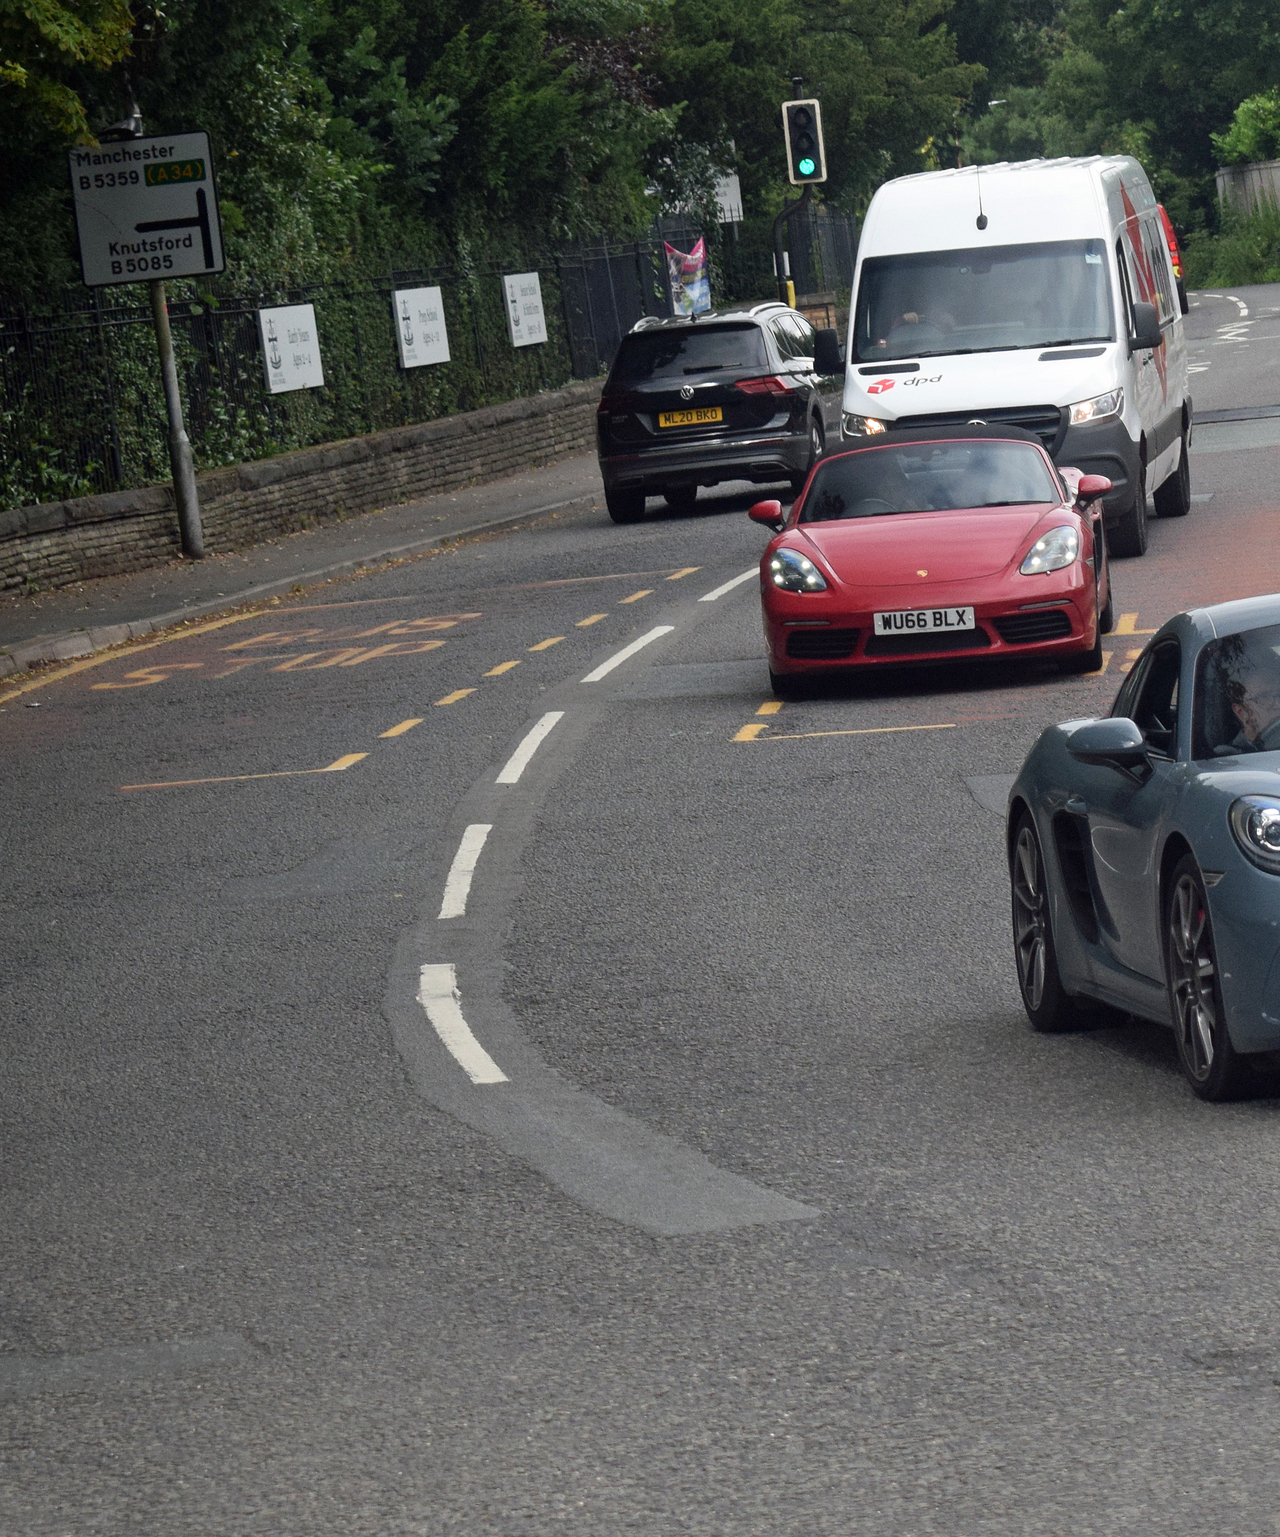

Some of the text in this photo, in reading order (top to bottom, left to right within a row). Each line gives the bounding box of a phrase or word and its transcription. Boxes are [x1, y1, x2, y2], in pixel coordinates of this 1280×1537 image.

[76, 145, 175, 167] Manchester
[109, 234, 193, 257] Knutsford
[903, 375, 943, 386] dpd
[664, 409, 718, 424] ML20 BKO
[882, 609, 967, 630] WU66 BLX
[89, 640, 447, 690] STOP
